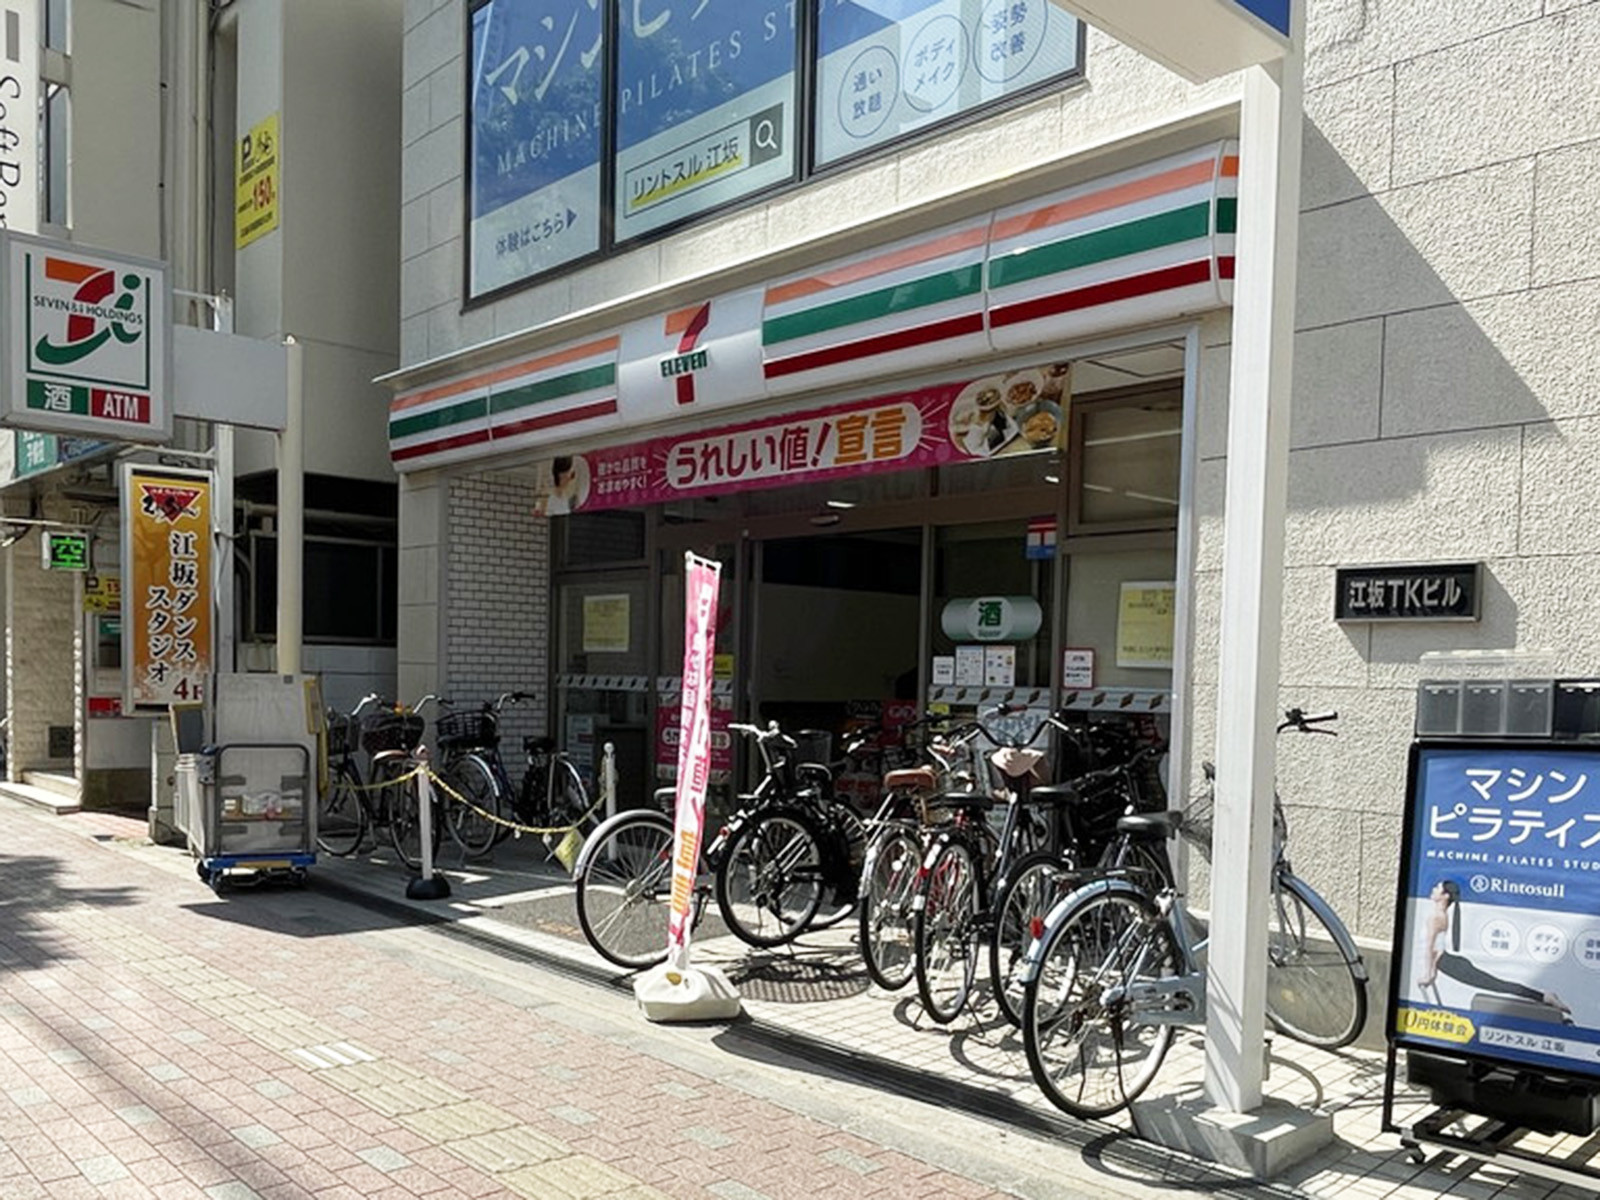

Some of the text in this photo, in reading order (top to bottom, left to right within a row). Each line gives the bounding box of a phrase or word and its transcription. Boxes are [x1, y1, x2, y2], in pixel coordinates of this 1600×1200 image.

[620, 30, 742, 114] PILATES
[633, 136, 740, 200] リントスル 江坂
[86, 305, 143, 325] HOLDINGS
[659, 347, 709, 378] ELEVEN
[44, 383, 71, 412] 酒
[103, 393, 139, 420] ATM
[51, 537, 85, 568] 空
[170, 532, 198, 662] 江坂ダンス
[1349, 577, 1462, 608] 江坂TKビル
[978, 601, 1003, 627] 酒
[149, 587, 173, 684] スタジオ
[1465, 768, 1587, 804] マシン
[1427, 850, 1489, 863] MACHINE
[1497, 855, 1554, 868] PILATES
[1490, 877, 1565, 898] Rintosull
[1485, 1030, 1566, 1053] リントスル 江坂
